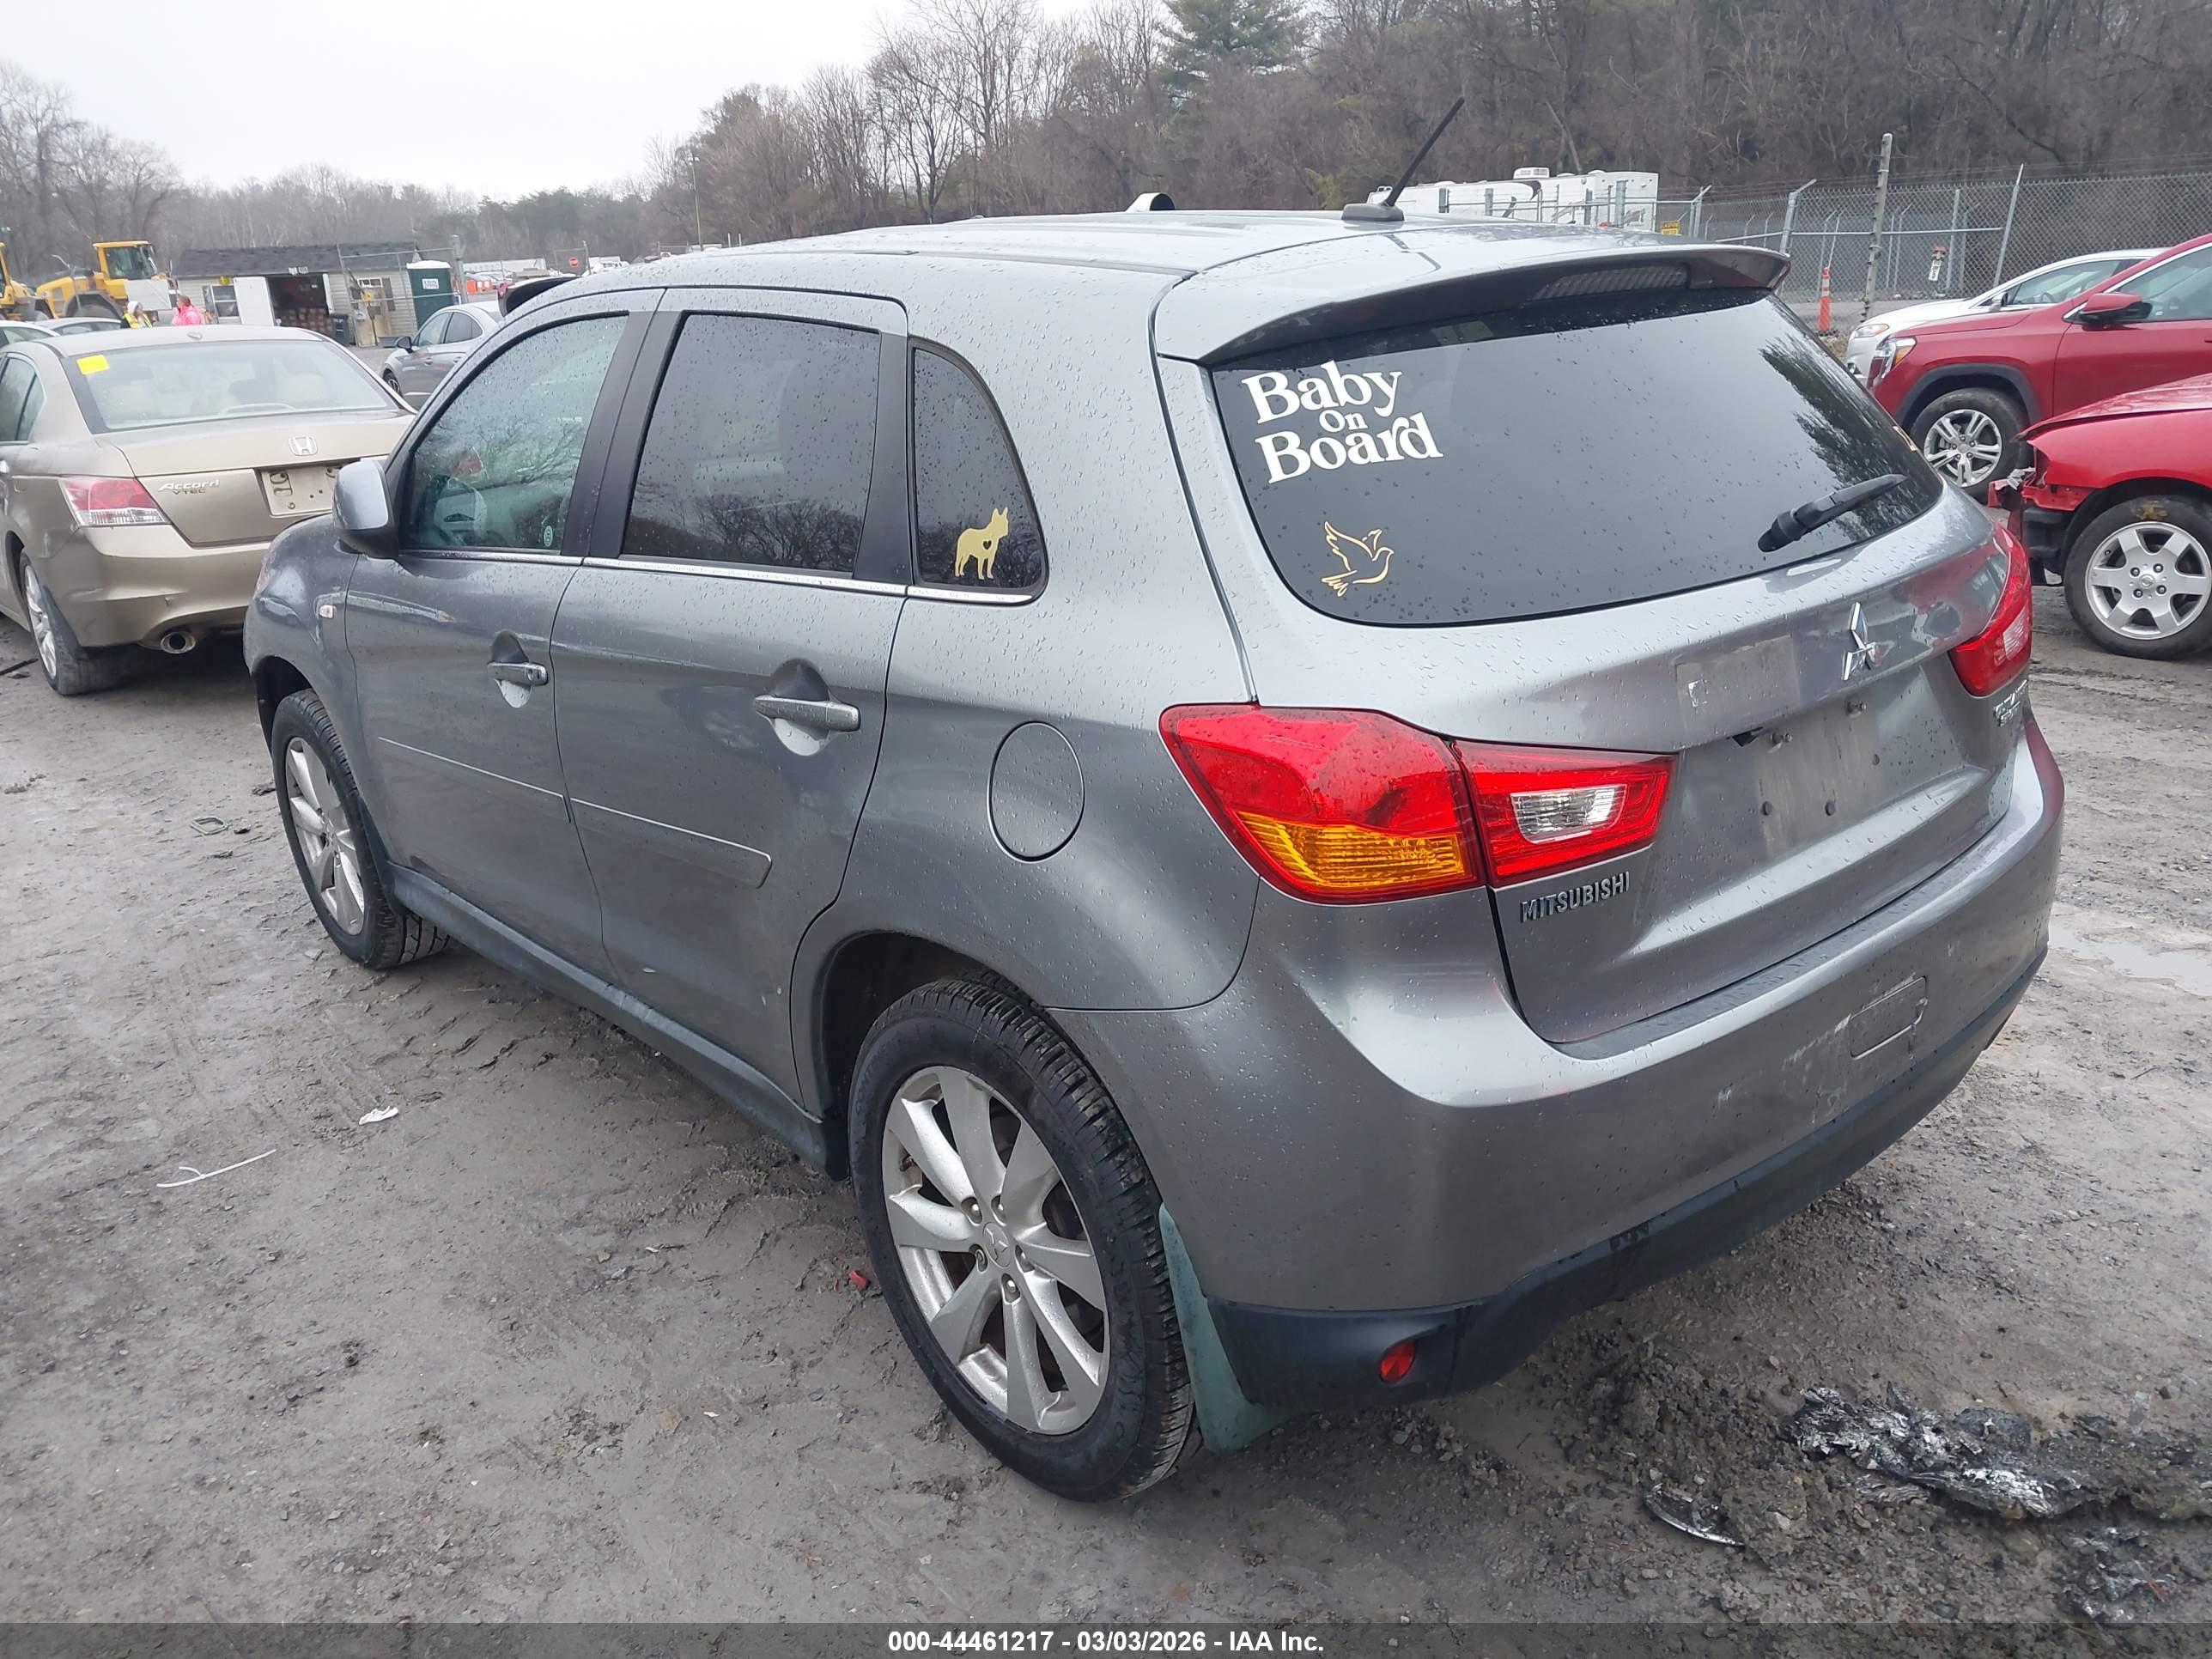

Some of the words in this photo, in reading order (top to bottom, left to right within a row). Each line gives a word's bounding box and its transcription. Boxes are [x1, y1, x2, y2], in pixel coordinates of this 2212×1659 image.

[1241, 360, 1402, 424] Baby
[1255, 411, 1444, 483] Board
[1319, 410, 1368, 433] On
[157, 479, 219, 492] Accord
[1521, 871, 1630, 923] MITSUBISHI
